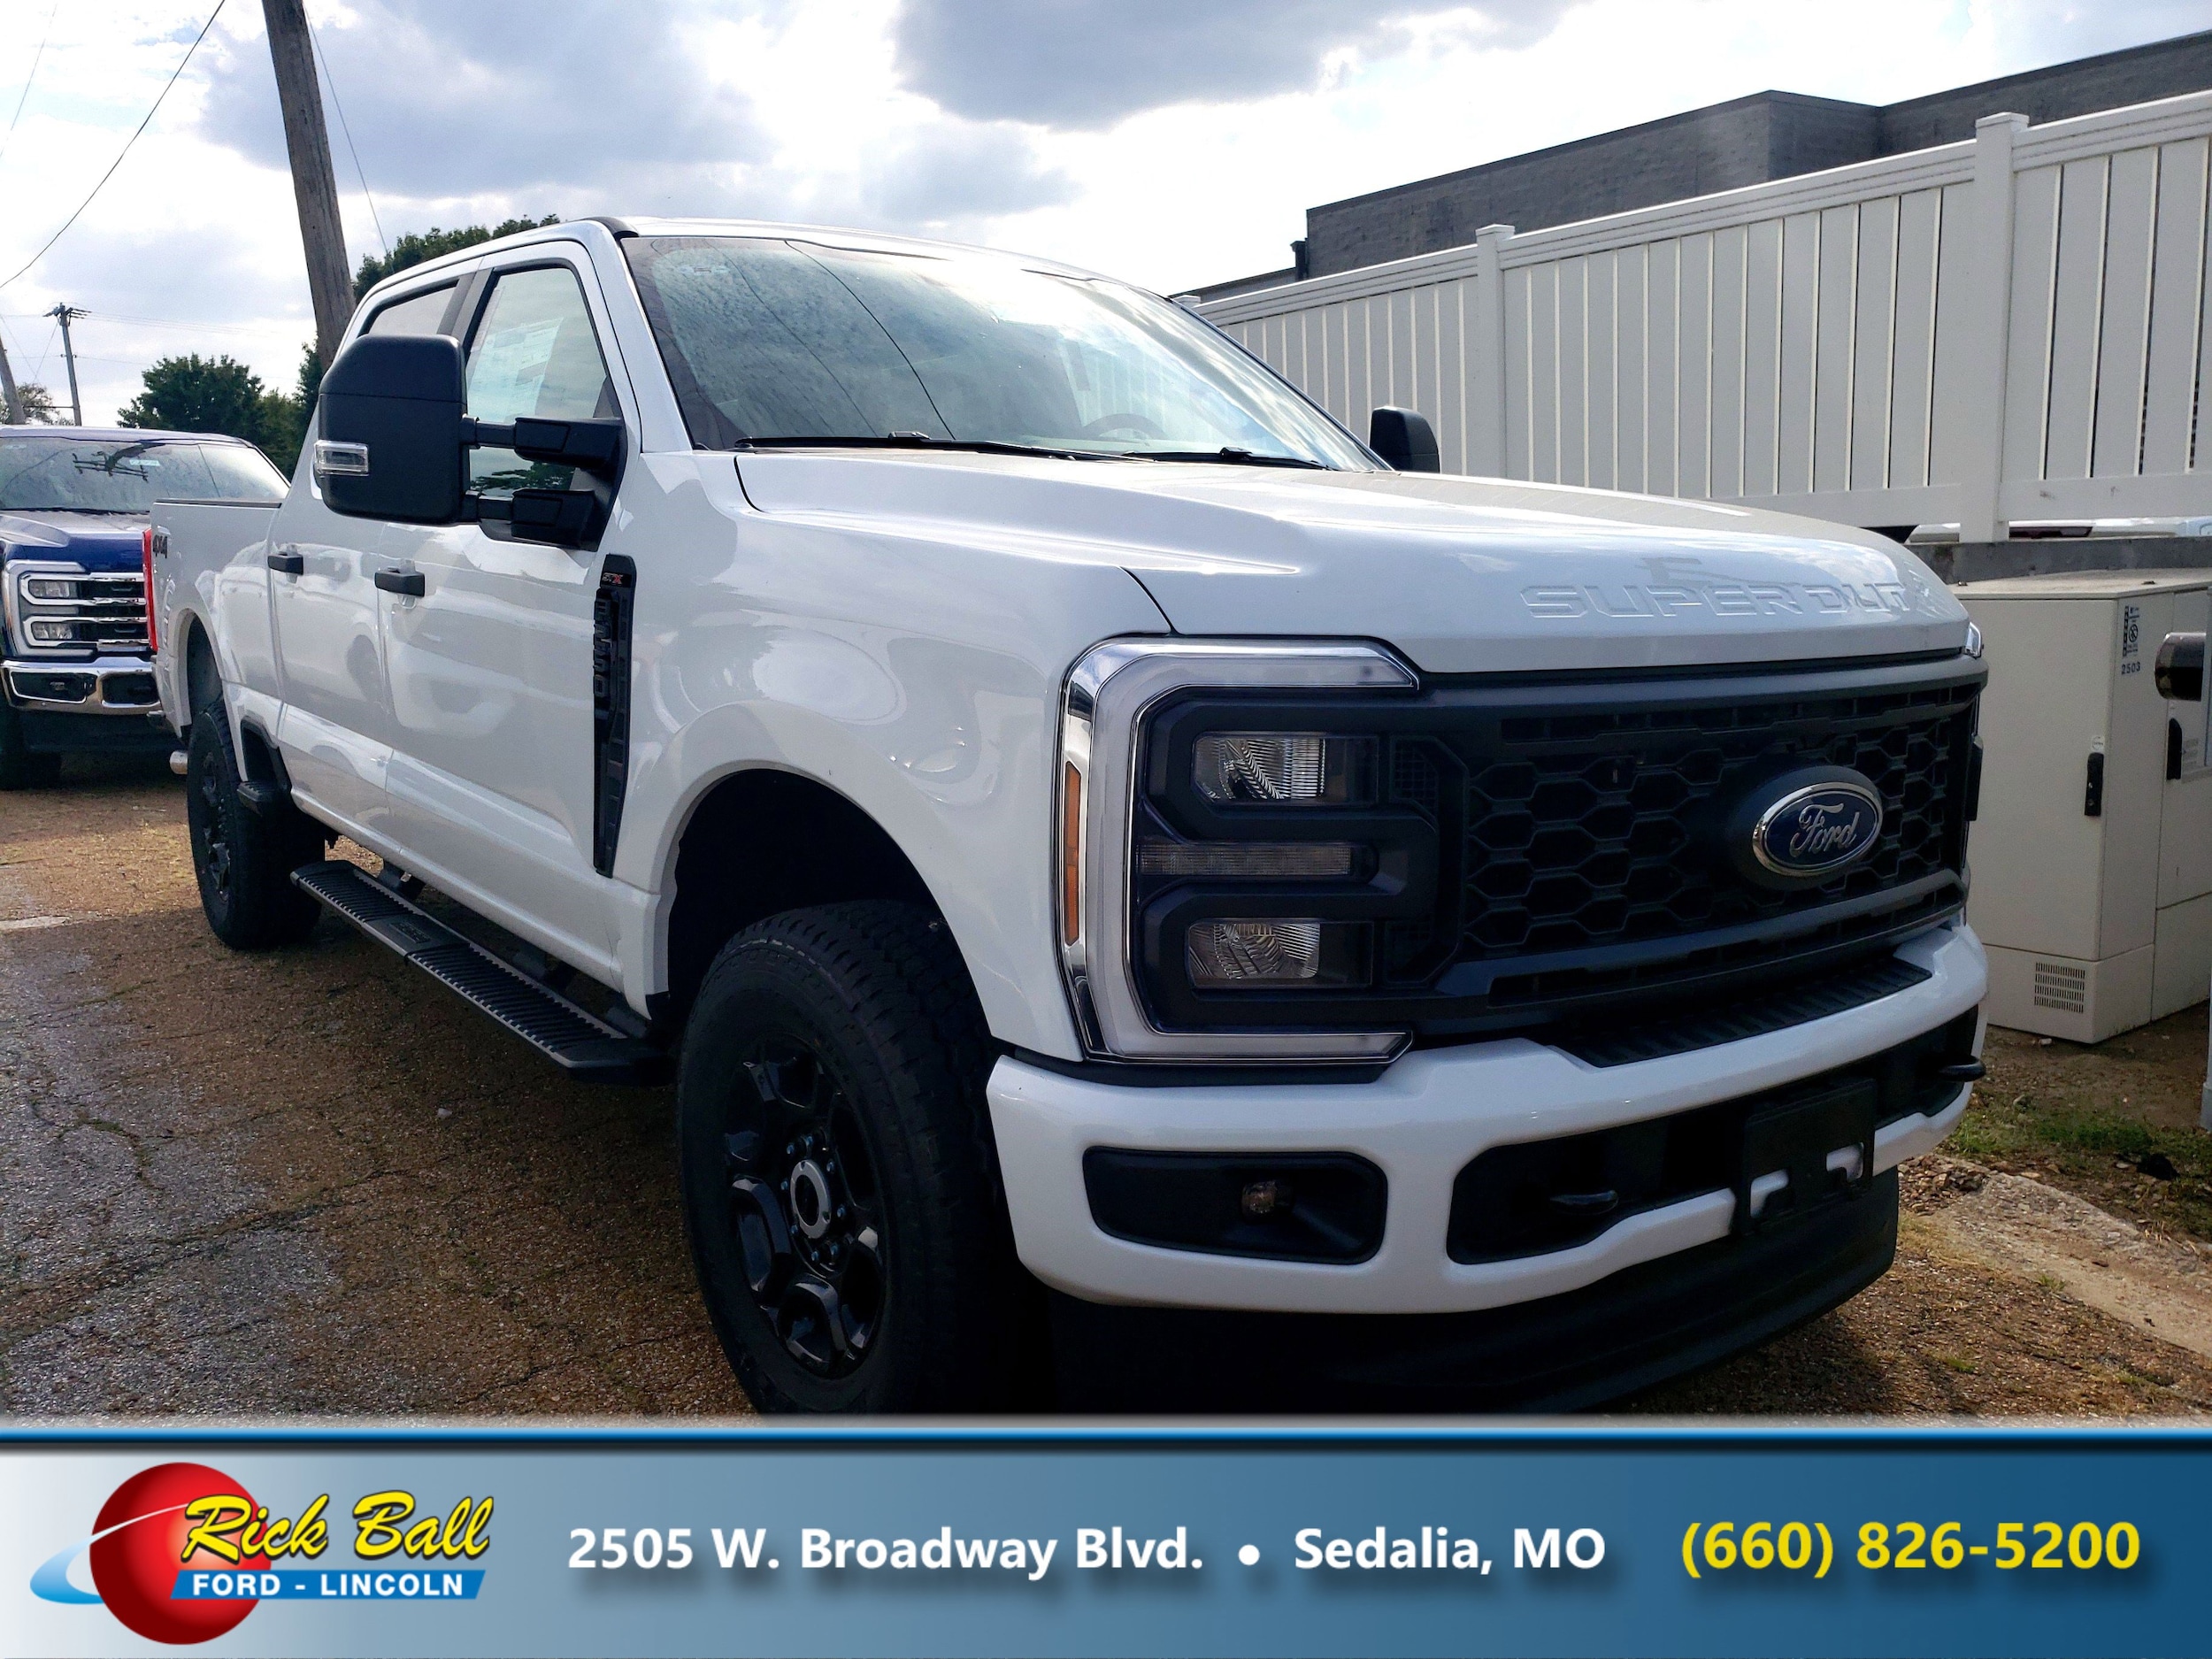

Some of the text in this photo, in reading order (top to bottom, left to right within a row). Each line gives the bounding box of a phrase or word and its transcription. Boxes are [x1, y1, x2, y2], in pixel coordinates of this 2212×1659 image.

[1519, 582, 1931, 618] SUPER DUT
[2121, 661, 2141, 675] 2503
[1789, 803, 1861, 857] Ford
